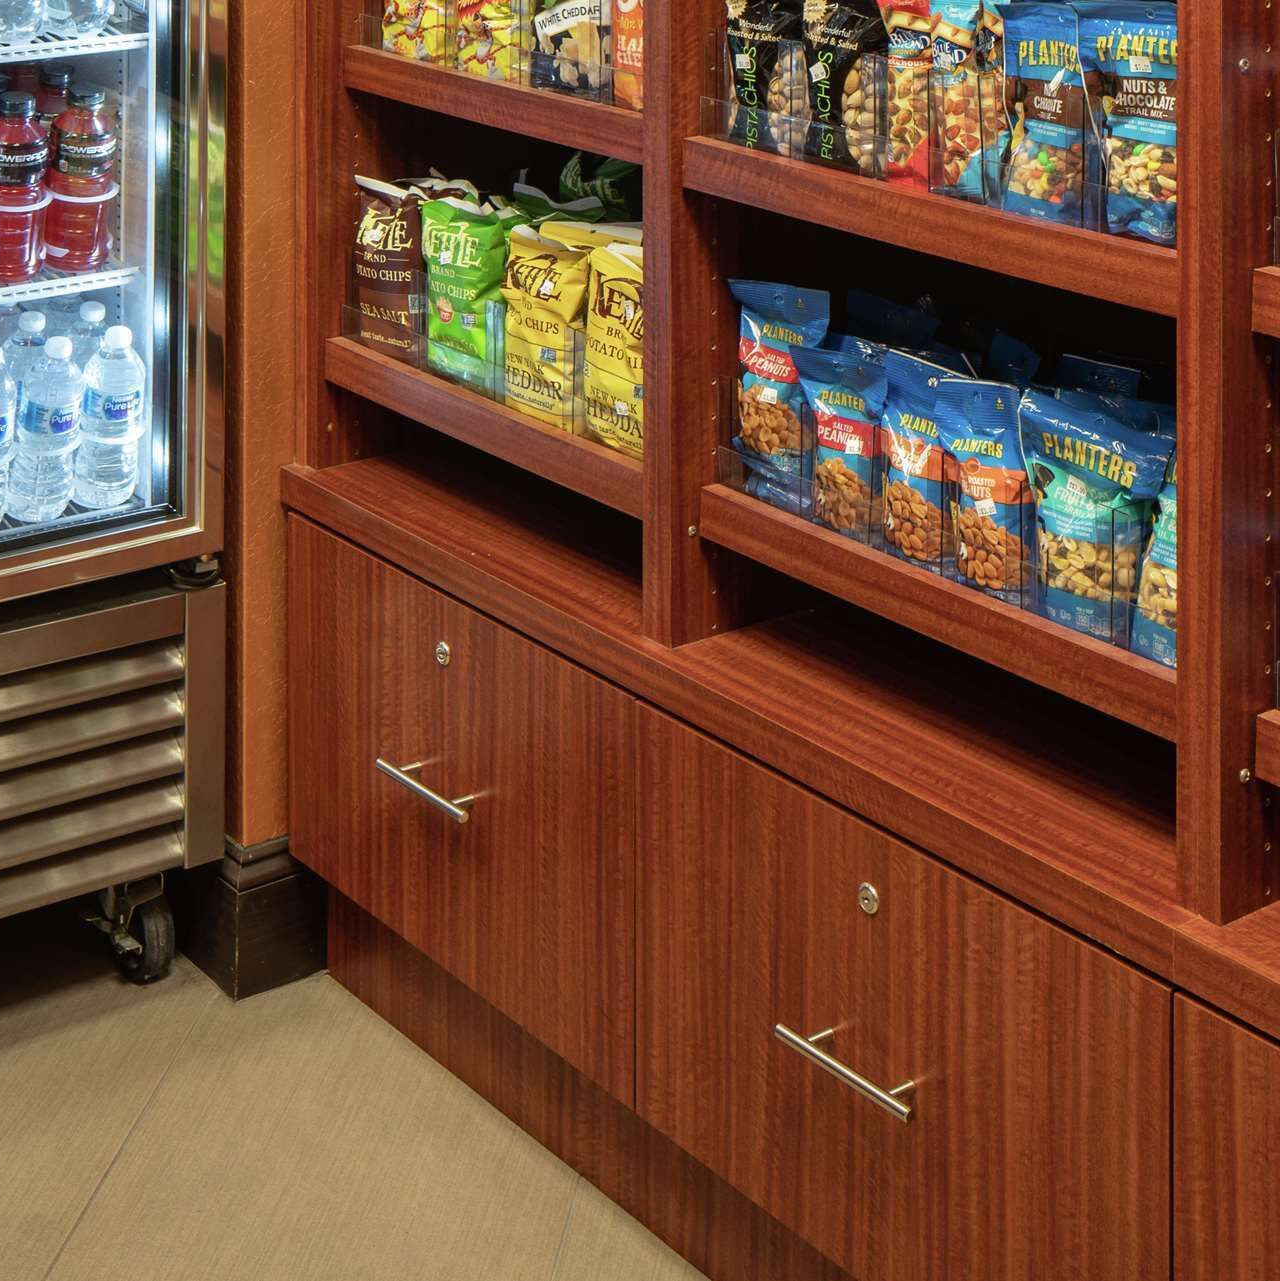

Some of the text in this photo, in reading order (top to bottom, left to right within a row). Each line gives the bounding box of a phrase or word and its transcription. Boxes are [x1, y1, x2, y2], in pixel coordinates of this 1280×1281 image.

[739, 19, 774, 31] Wonderful
[818, 25, 852, 38] Wonderful
[1123, 80, 1155, 95] NUTS
[1124, 109, 1163, 118] TRAIL MIX
[379, 270, 412, 281] CHIPS
[448, 287, 476, 300] CHIPS
[381, 309, 408, 325] SALT
[525, 318, 560, 334] CHIPS
[761, 323, 803, 346] PLANTERS
[749, 355, 791, 377] PEANUTS
[833, 422, 853, 432] SALTED
[951, 438, 1002, 458] PLANTERS
[1042, 432, 1136, 489] PLANTERS
